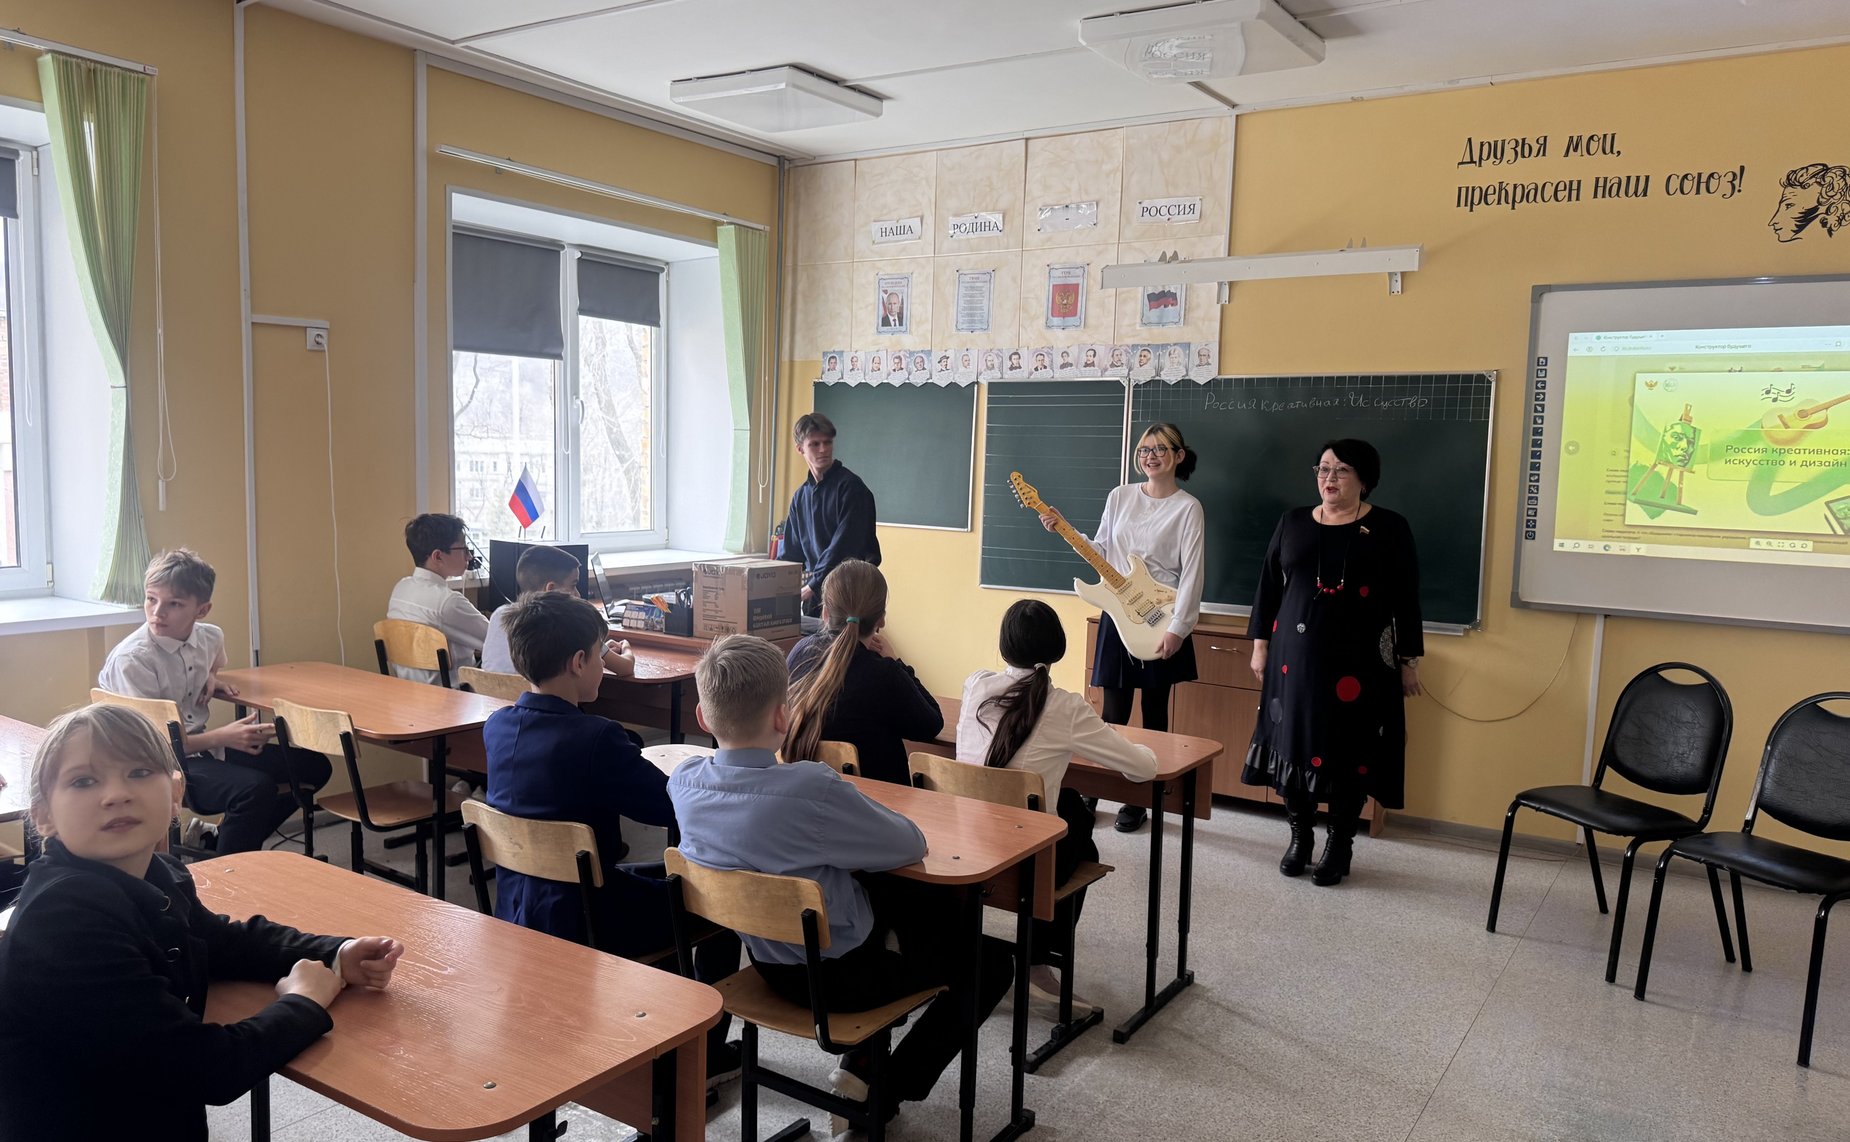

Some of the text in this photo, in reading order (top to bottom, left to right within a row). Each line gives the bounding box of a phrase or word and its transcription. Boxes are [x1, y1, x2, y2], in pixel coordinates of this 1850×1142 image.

[1457, 132, 1621, 168] Друзья мои,
[1456, 165, 1745, 212] прекрасен наш союз!
[879, 224, 914, 238] НАША
[952, 220, 1000, 235] РОДИНА
[1141, 203, 1196, 218] РОССИЯ
[1204, 391, 1257, 411] Россия
[1724, 457, 1785, 467] искусство
[1800, 458, 1847, 468] дизайн
[1725, 444, 1768, 455] Россия
